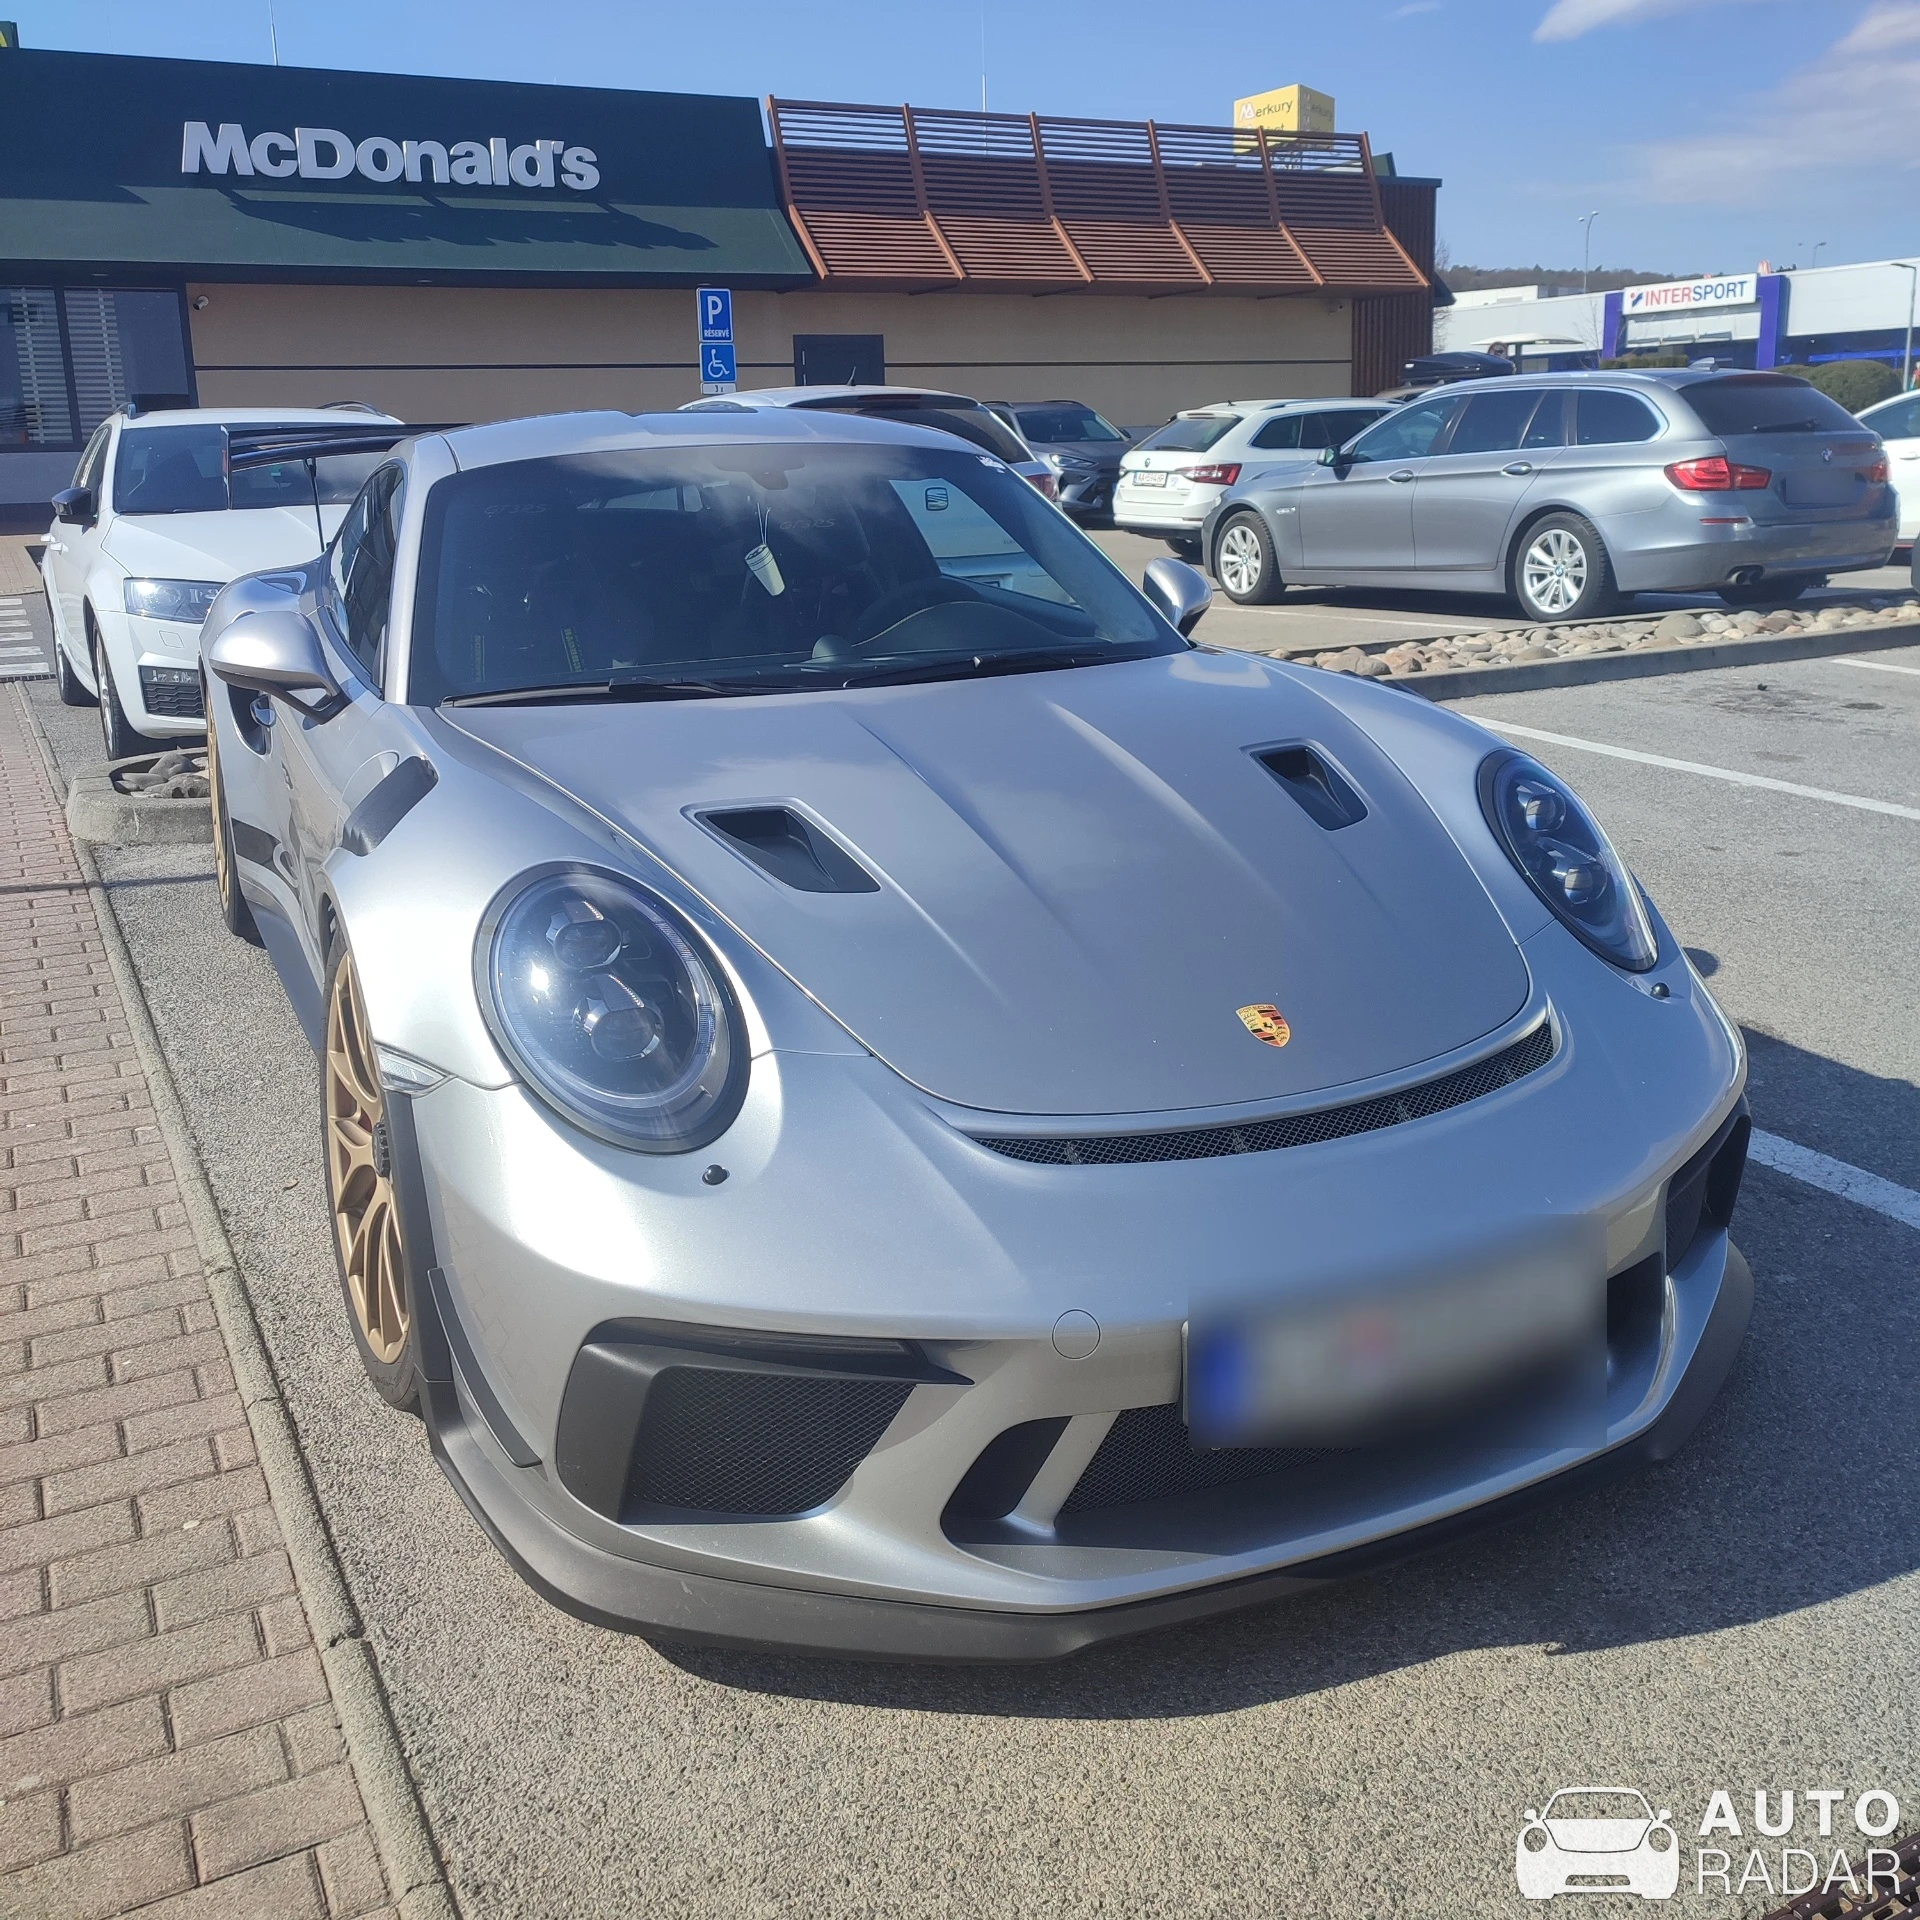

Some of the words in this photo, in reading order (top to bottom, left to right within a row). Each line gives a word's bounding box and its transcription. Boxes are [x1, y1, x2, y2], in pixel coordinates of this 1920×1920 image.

[1239, 100, 1293, 121] Merkury
[181, 121, 600, 191] McDonald's
[1645, 281, 1748, 307] INTERSPORT
[707, 295, 723, 325] P
[703, 327, 730, 338] RÉSERVÉ
